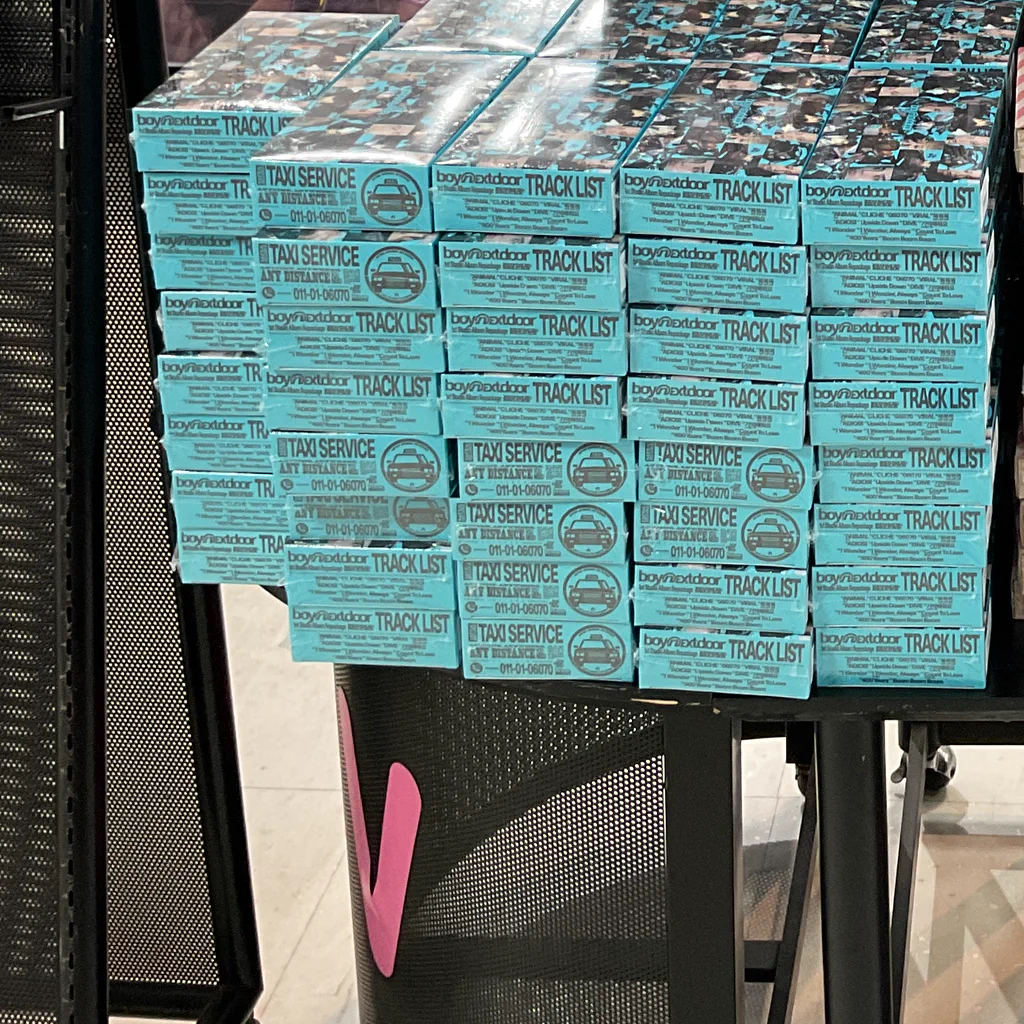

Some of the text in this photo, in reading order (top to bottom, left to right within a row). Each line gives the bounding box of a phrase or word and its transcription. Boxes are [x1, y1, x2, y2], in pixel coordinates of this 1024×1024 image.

[221, 115, 268, 136] TRACK
[267, 165, 356, 188] TAXI SERVICE
[525, 174, 605, 198] TRACK LIST
[713, 179, 793, 205] TRACK LIST
[894, 185, 974, 208] TRACK LIST
[270, 244, 359, 266] TAXI SERVICE
[902, 250, 981, 273] TRACK LIST
[356, 312, 436, 333] TRACK LIST
[474, 442, 562, 463] TAXI SERVICE
[656, 445, 742, 466] TAXI SERVICE
[904, 633, 980, 654] TRACK LIST
